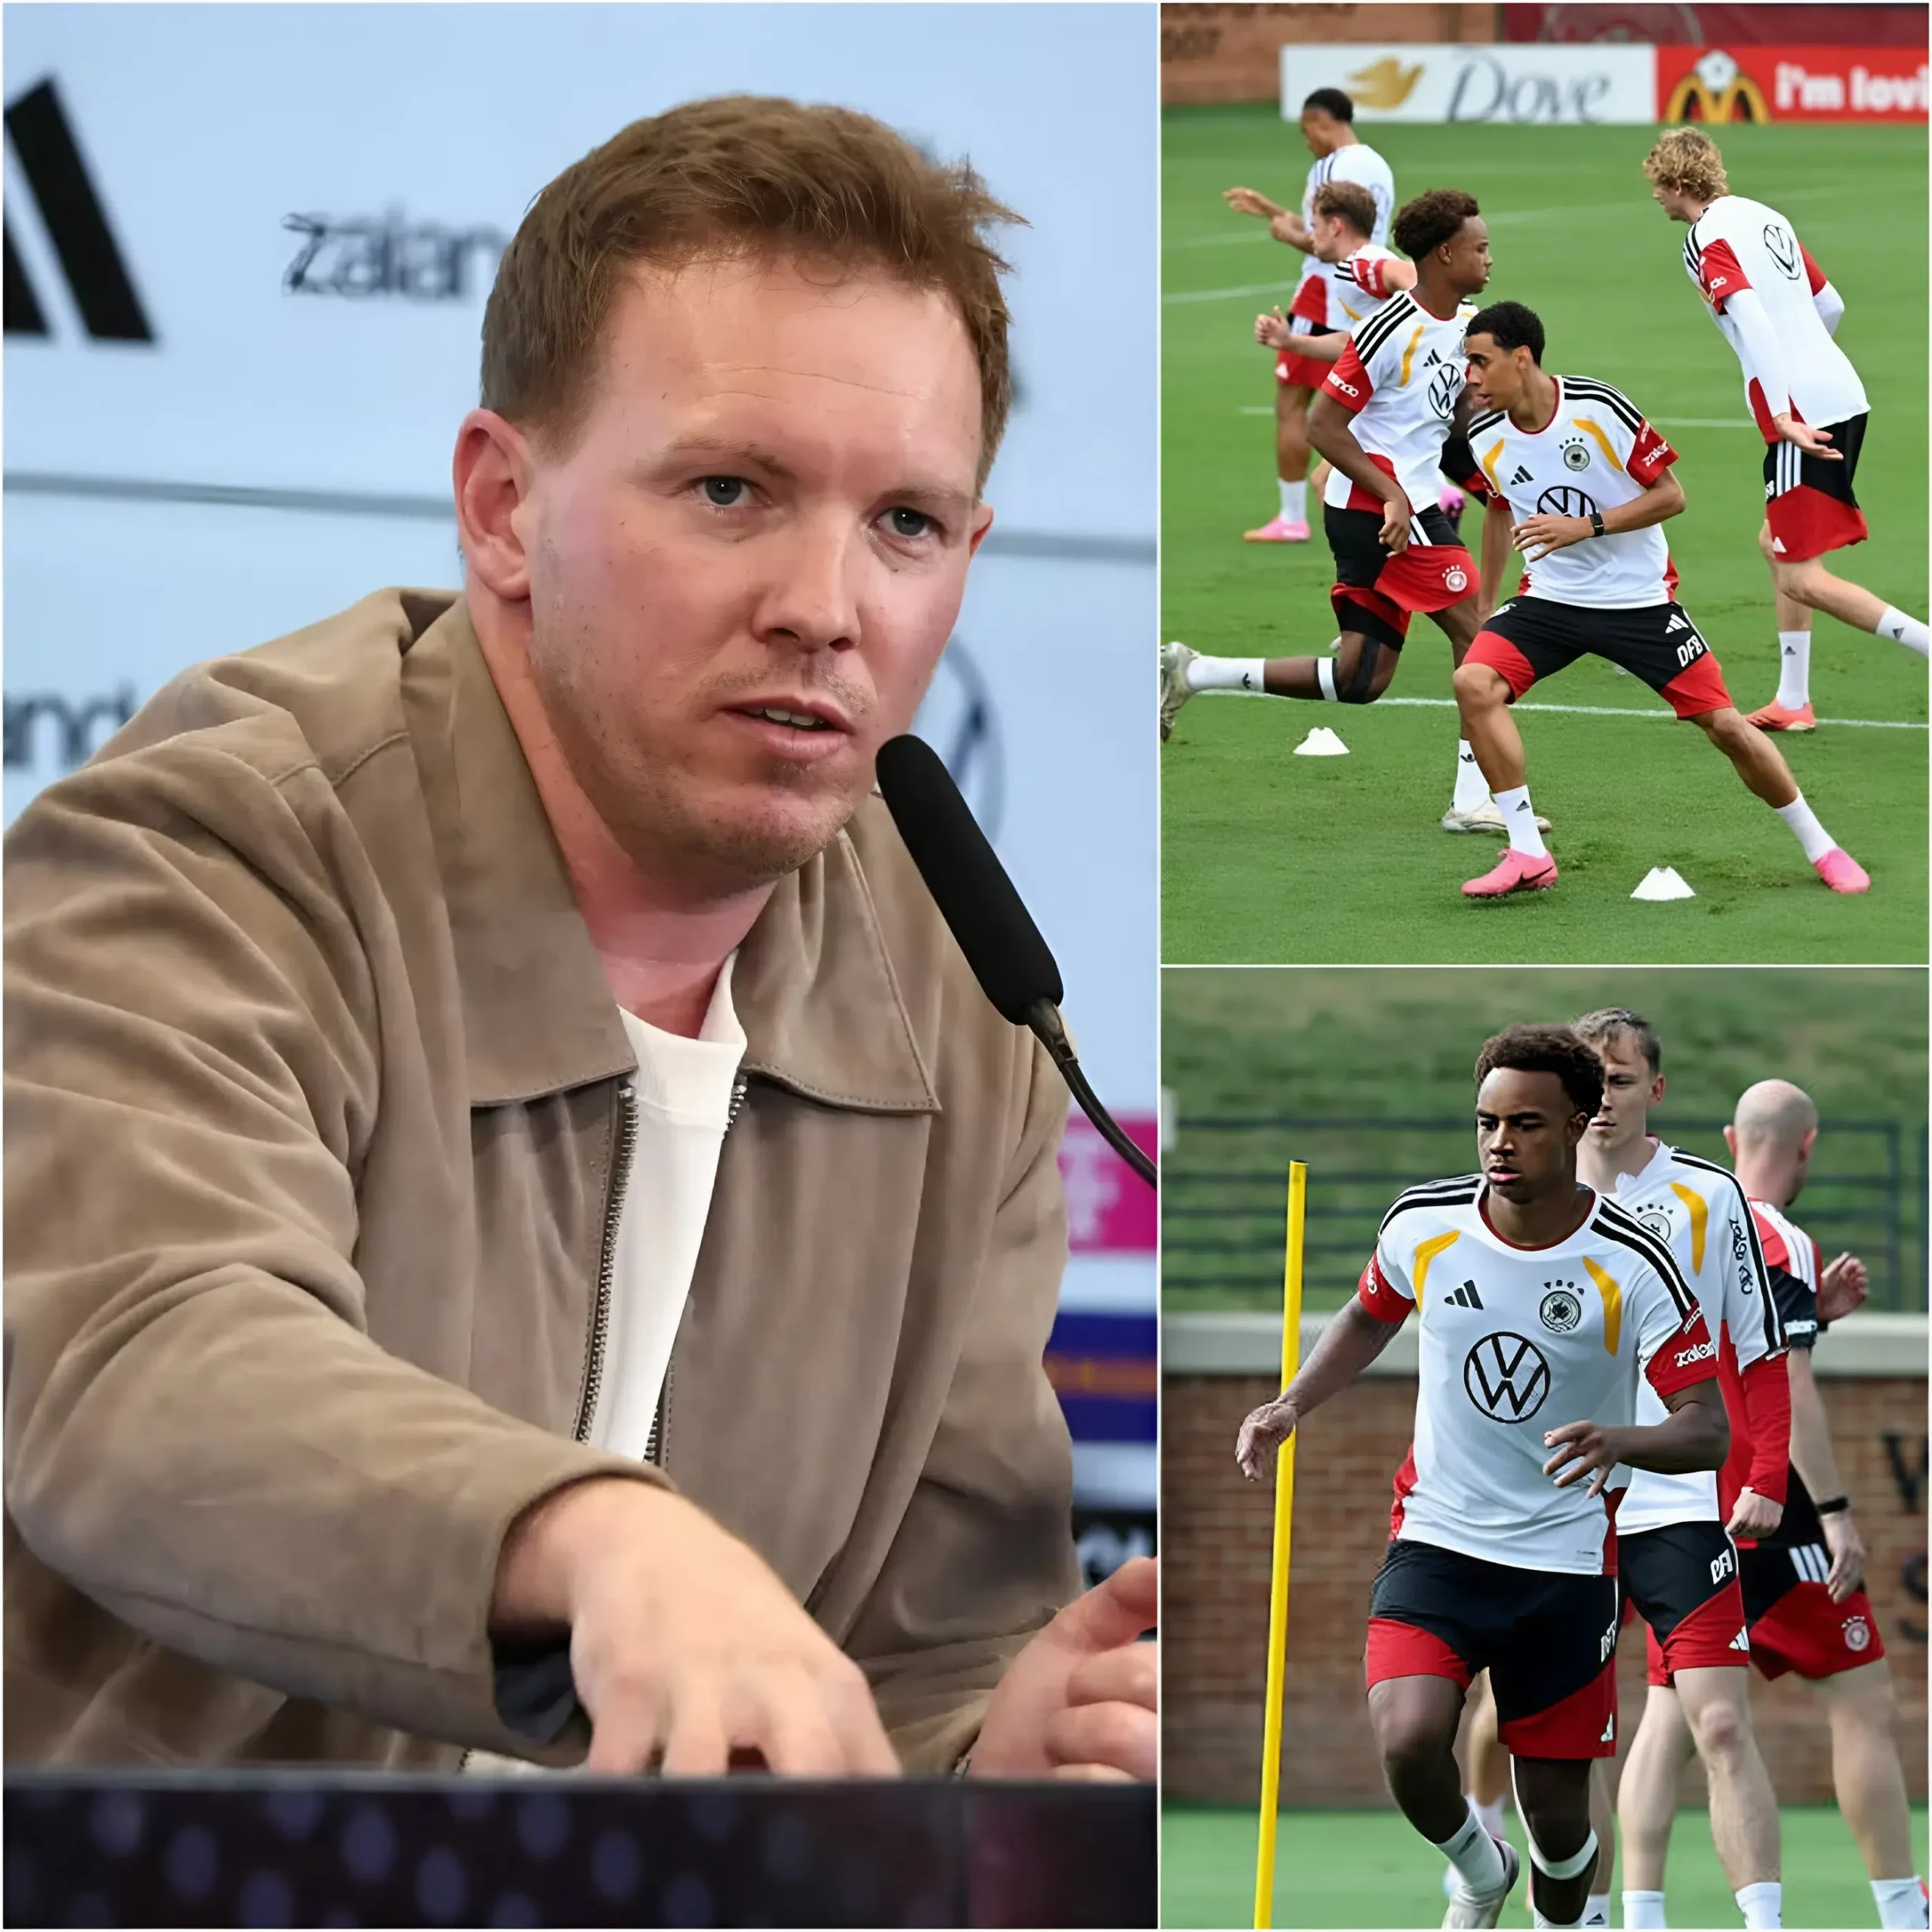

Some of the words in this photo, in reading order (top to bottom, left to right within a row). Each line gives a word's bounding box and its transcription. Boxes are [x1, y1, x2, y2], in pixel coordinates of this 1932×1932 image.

[1446, 47, 1613, 123] Dove
[1776, 60, 1844, 110] i'm
[1676, 635, 1703, 668] DFB
